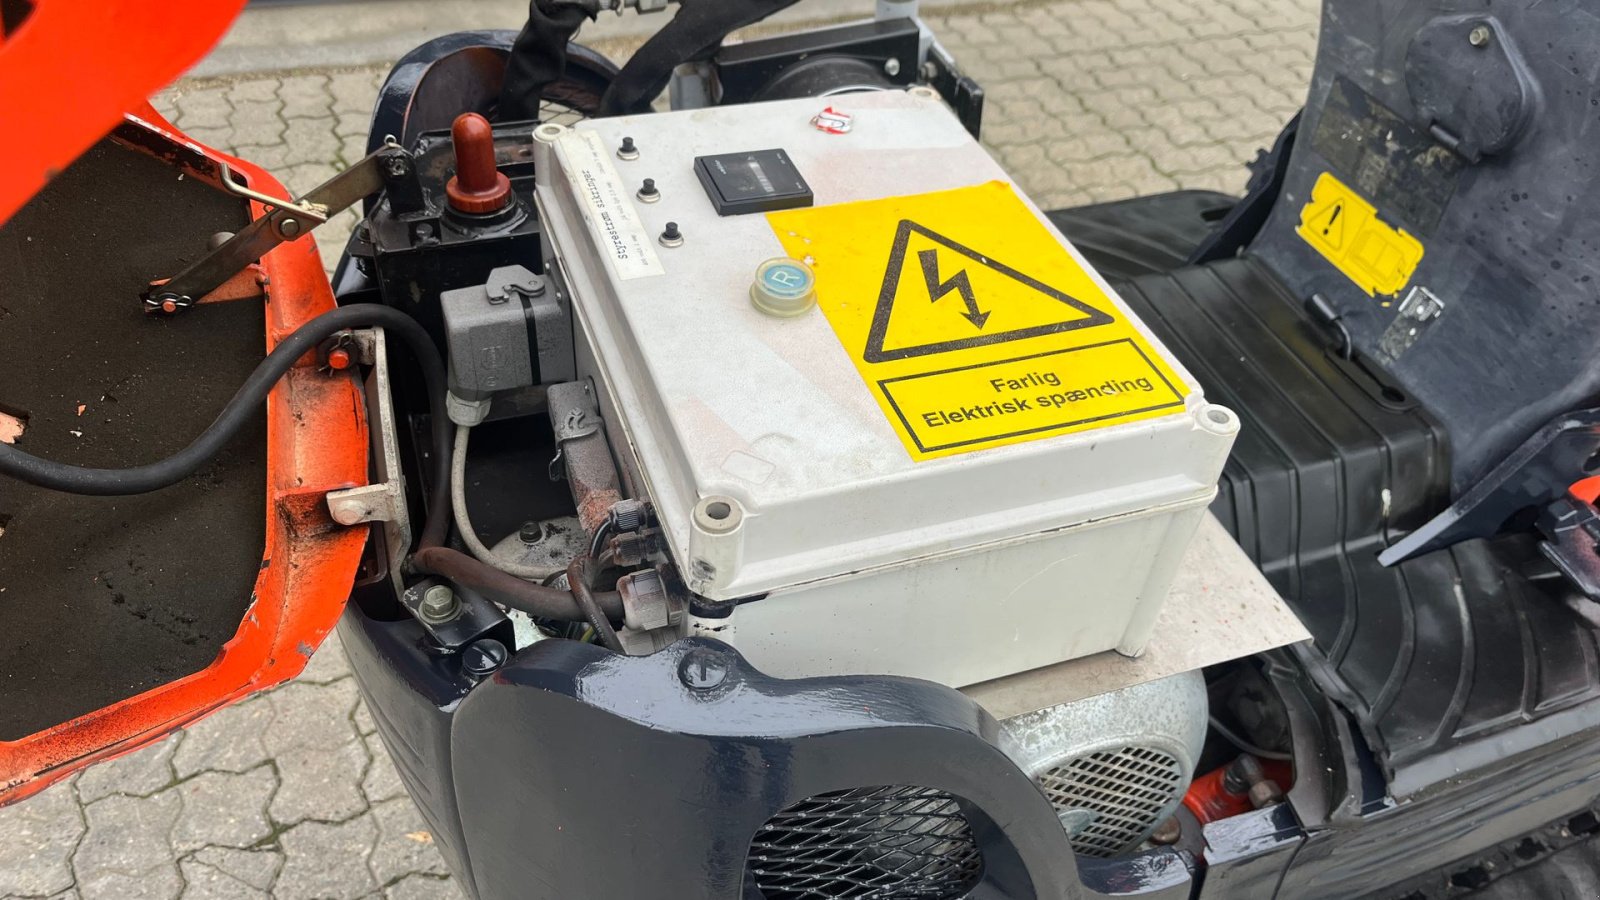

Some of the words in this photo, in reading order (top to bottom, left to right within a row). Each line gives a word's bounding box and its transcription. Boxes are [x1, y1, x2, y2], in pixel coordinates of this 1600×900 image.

[582, 170, 605, 208] sikringer
[601, 211, 628, 260] Styrestrøm
[771, 270, 800, 287] R
[990, 371, 1062, 393] Farlig
[922, 398, 1034, 428] Elektrisk
[1036, 376, 1154, 409] spænding
